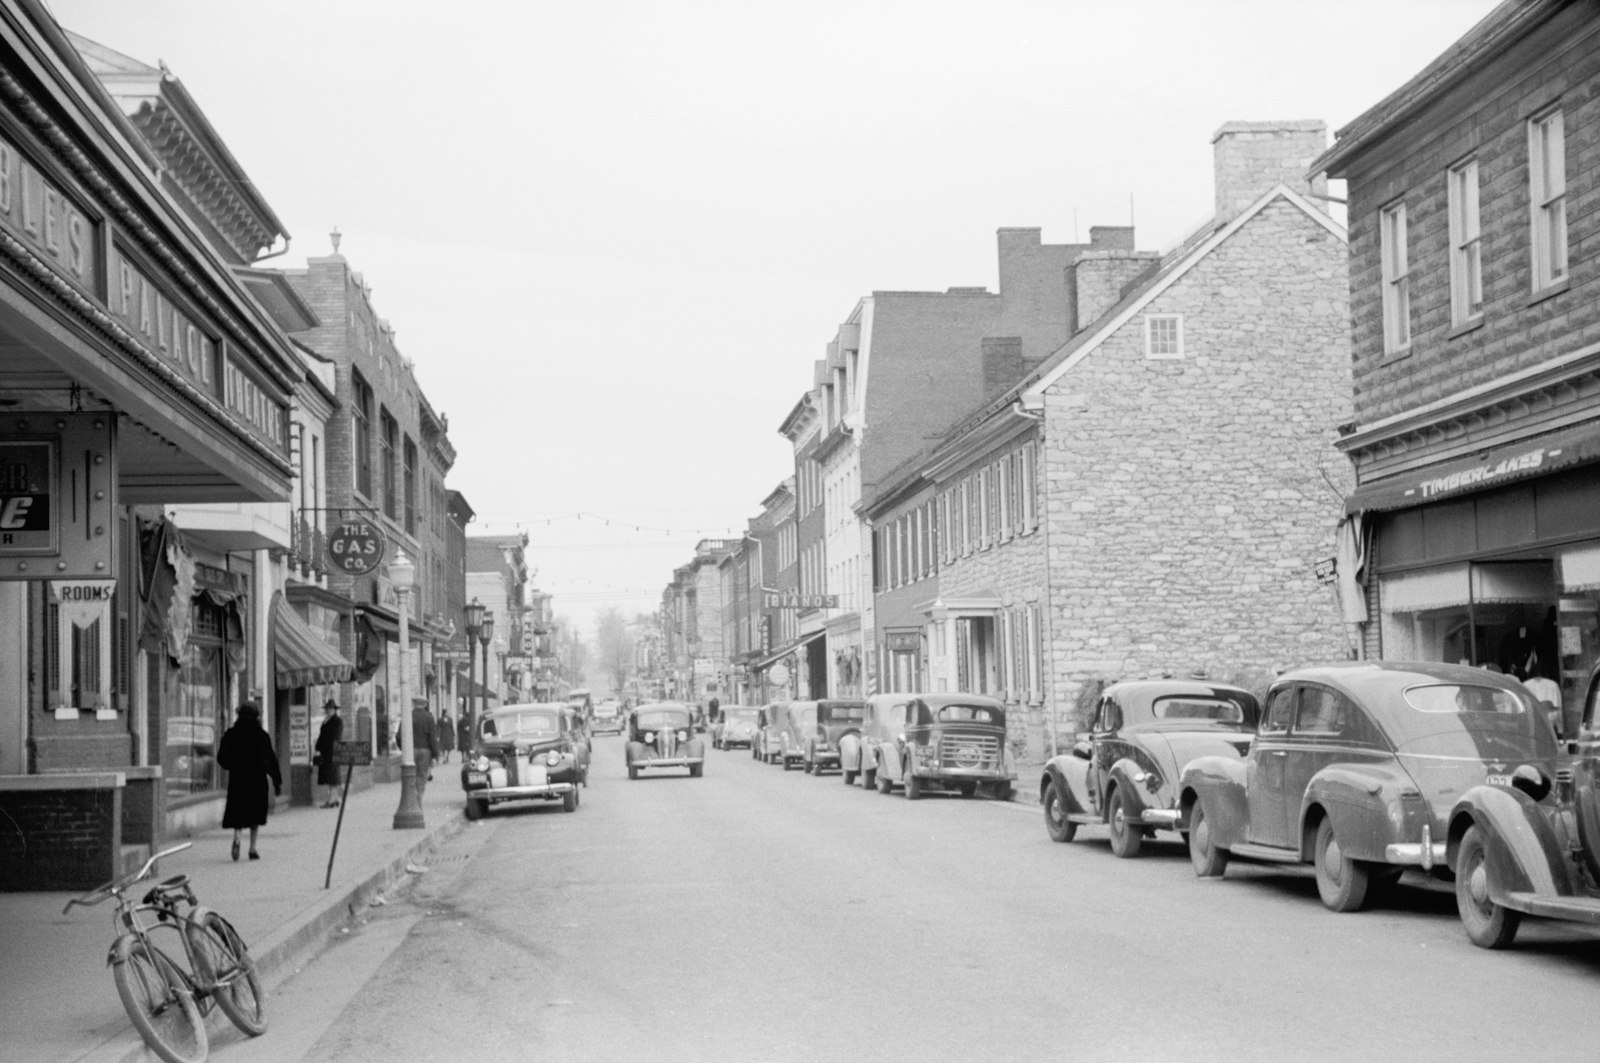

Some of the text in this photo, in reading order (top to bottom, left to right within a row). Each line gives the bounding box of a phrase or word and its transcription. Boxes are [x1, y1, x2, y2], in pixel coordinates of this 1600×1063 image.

[119, 257, 210, 386] PALACE
[227, 362, 282, 447] THEATRE
[1420, 448, 1546, 498] TIMBERLAKES
[342, 524, 369, 536] THE
[332, 539, 377, 554] GAS
[344, 557, 368, 570] CO.
[62, 585, 112, 602] ROOMS
[770, 594, 834, 608] PIANOS
